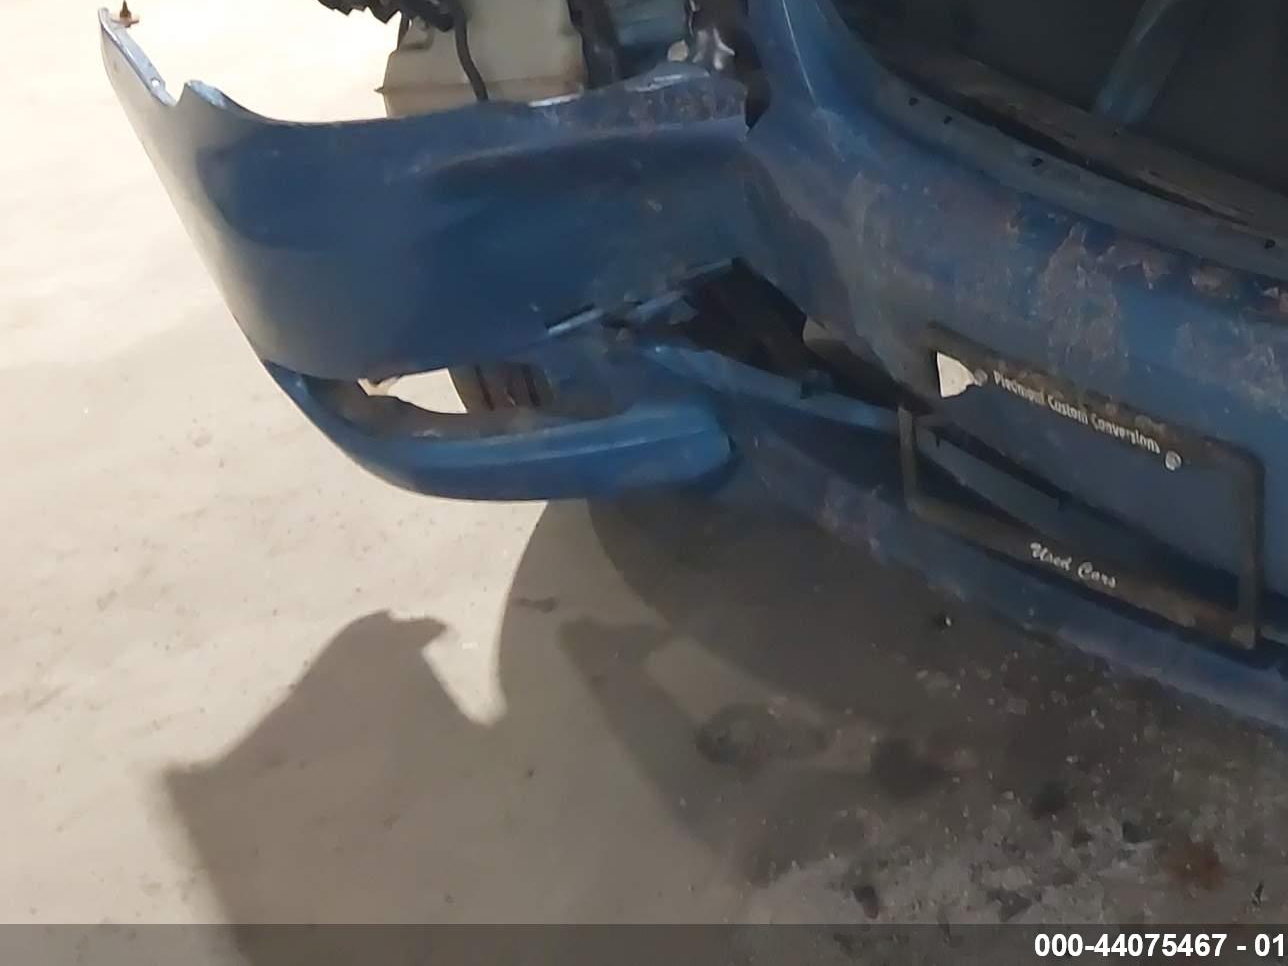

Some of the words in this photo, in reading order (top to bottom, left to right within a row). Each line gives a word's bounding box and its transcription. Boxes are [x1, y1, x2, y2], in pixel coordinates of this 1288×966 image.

[1047, 395, 1089, 425] Custom
[1090, 413, 1161, 454] Conversions
[1030, 542, 1072, 571] Used
[1078, 561, 1117, 589] Cars
